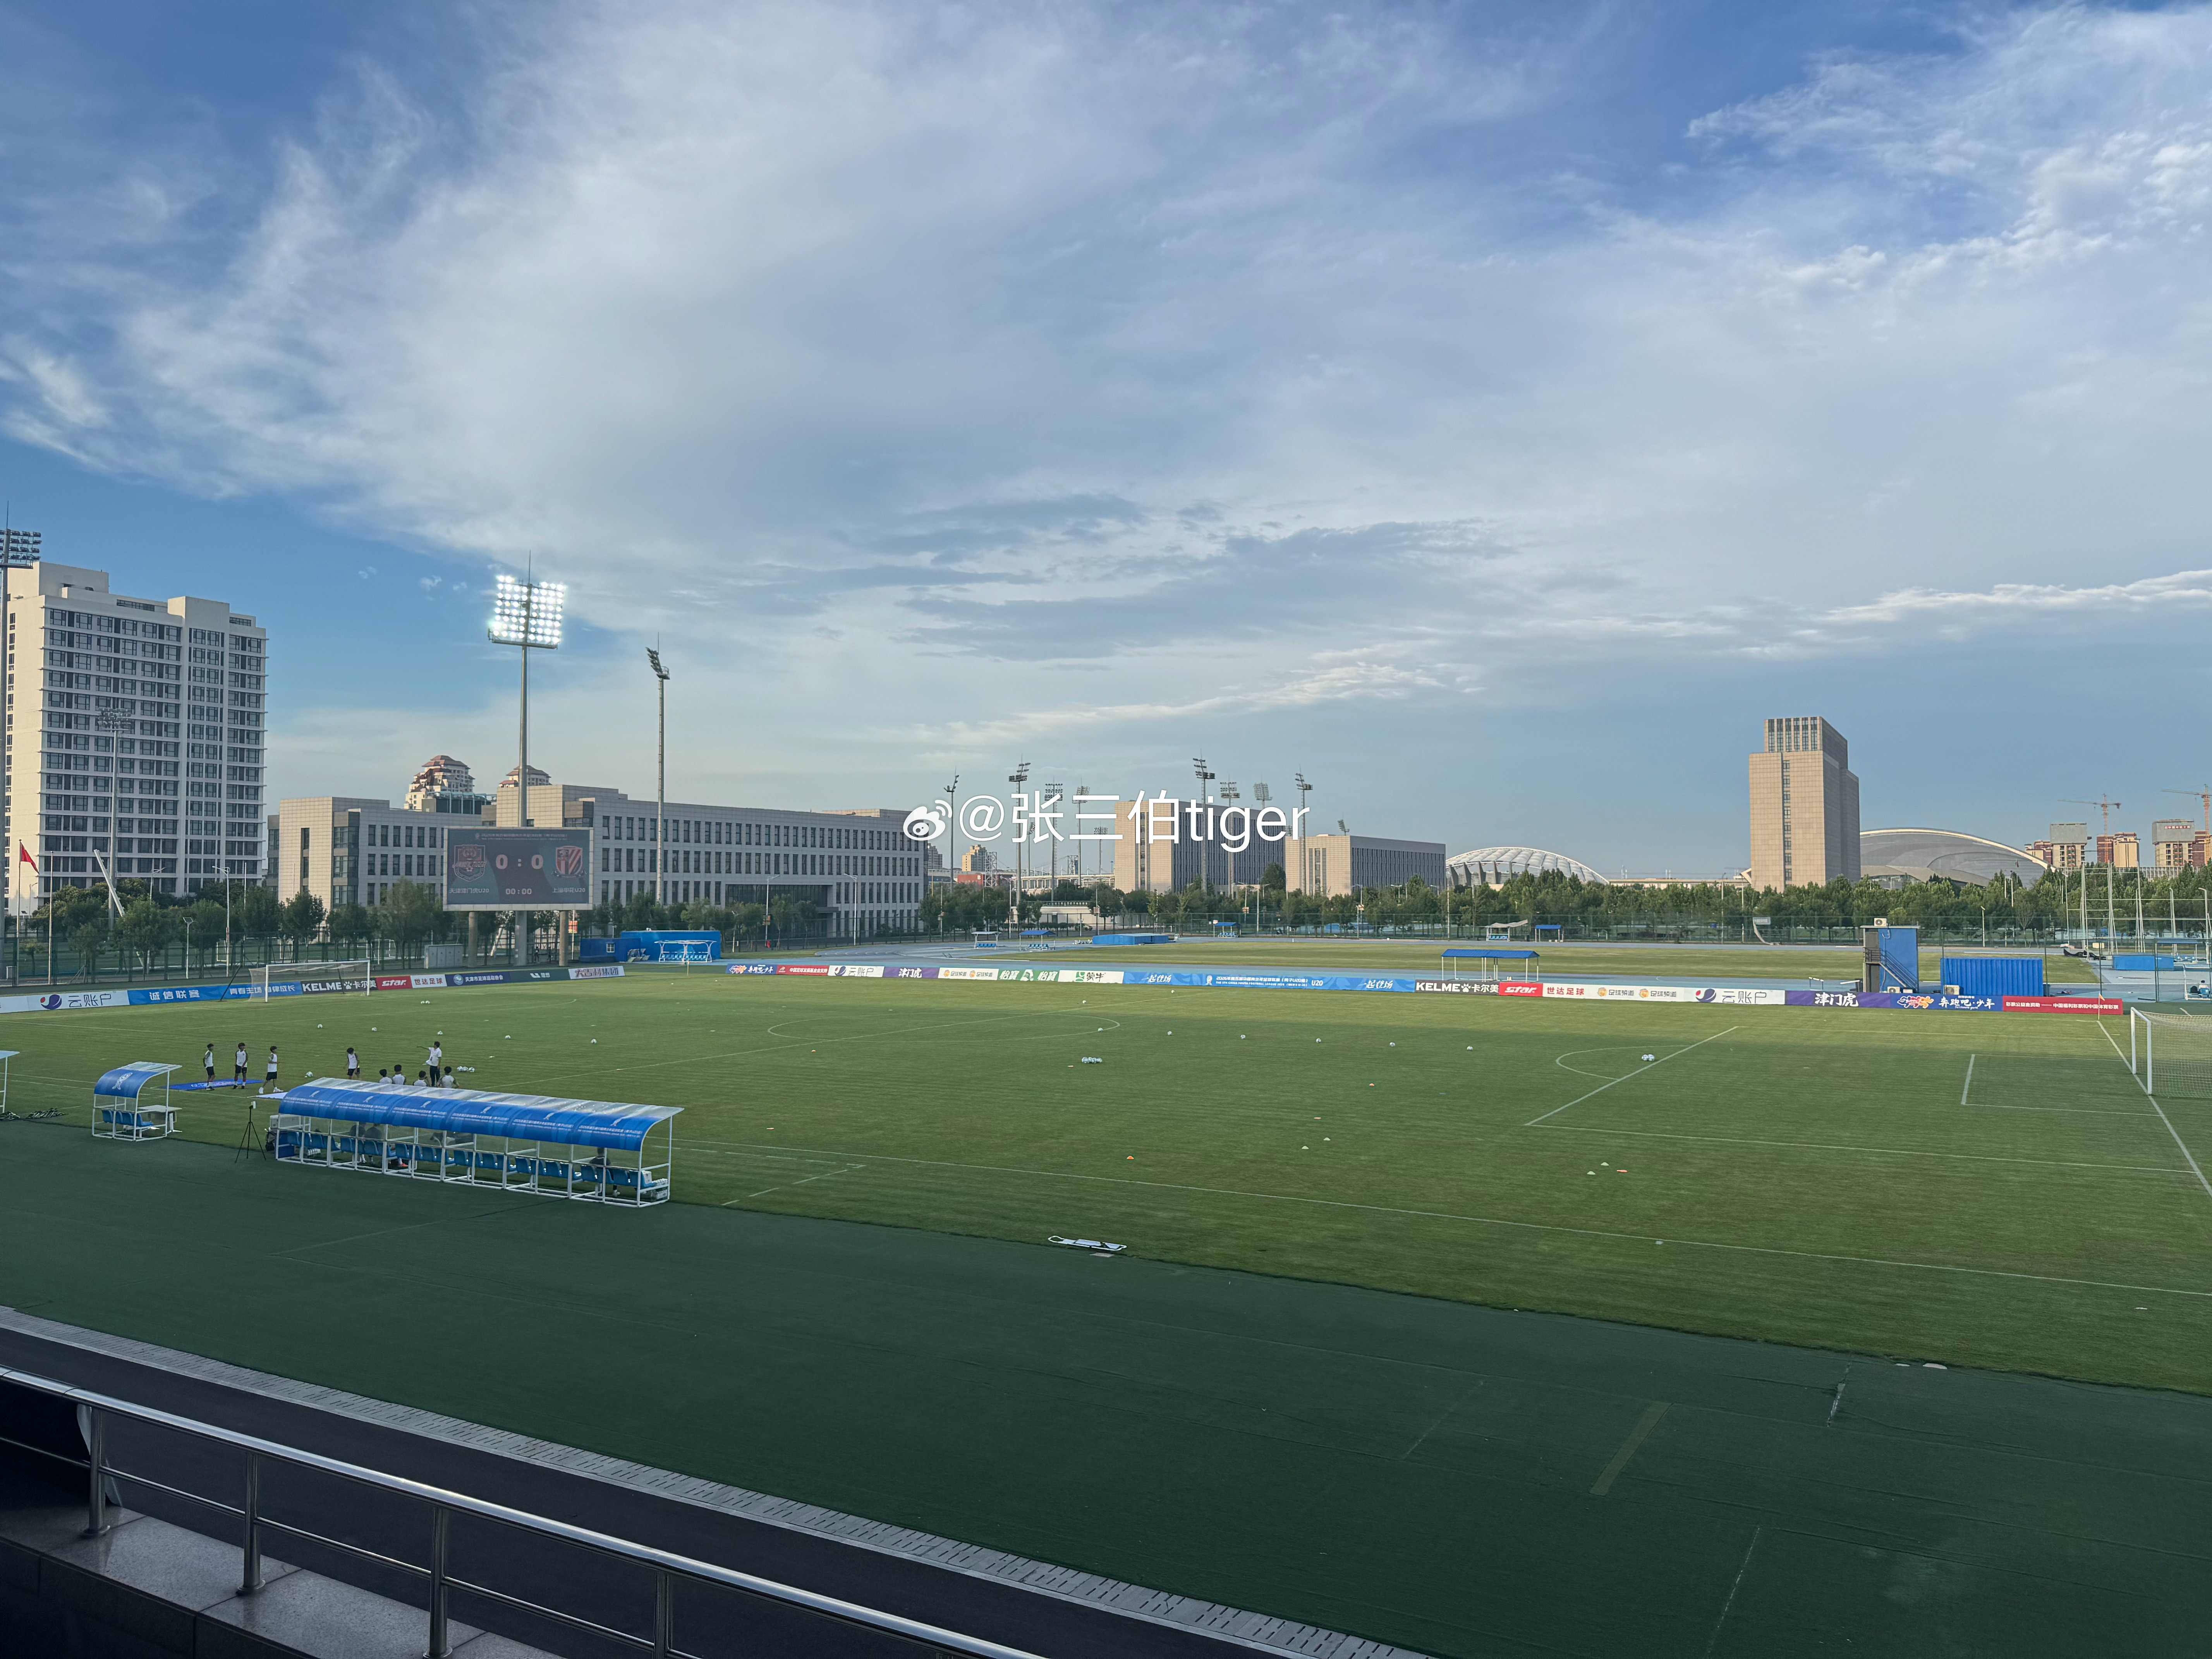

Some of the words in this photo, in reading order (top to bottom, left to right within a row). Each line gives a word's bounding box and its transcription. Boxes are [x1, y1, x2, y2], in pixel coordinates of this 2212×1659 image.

[496, 854, 508, 869] 0
[531, 854, 543, 869] 0
[848, 968, 874, 977] 云账户
[898, 968, 922, 978] 津门虎
[1087, 972, 1104, 982] 蒙牛
[302, 982, 342, 992] KELME
[1416, 982, 1461, 992] KELME
[1471, 984, 1499, 993] 卡尔美
[1547, 987, 1584, 995] 世达足球
[149, 989, 200, 1001] 诚信联赛
[1722, 991, 1767, 1004] 云账户
[1815, 993, 1859, 1006] 津门虎
[68, 993, 111, 1008] 云账户
